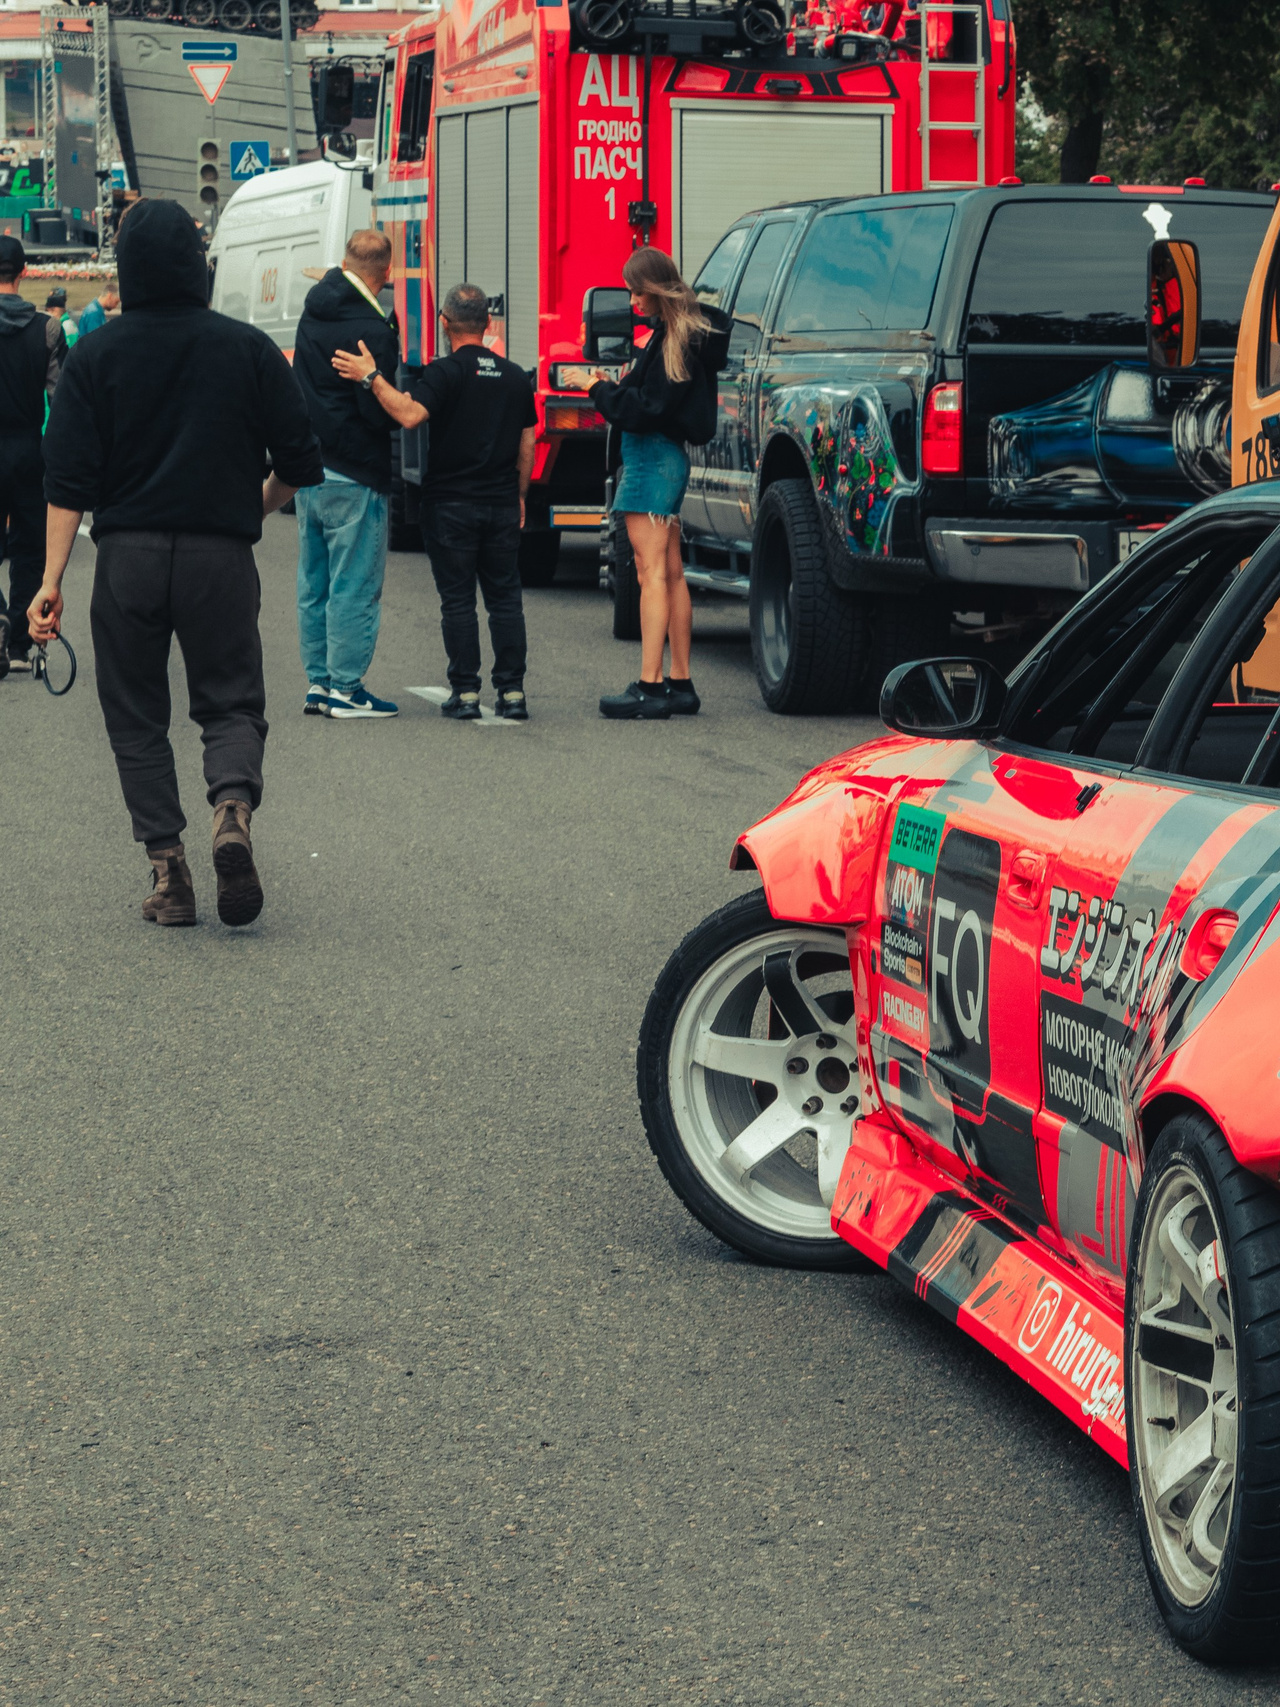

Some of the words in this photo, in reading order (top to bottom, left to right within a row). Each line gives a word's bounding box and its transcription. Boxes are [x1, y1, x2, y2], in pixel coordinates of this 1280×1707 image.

[578, 54, 640, 118] АЦ
[578, 119, 642, 145] ГРОДНО
[574, 146, 643, 180] ПАСЧ
[604, 187, 616, 220] 1
[891, 868, 925, 917] ATOM
[884, 949, 906, 975] Sports
[932, 896, 985, 1045] FQ
